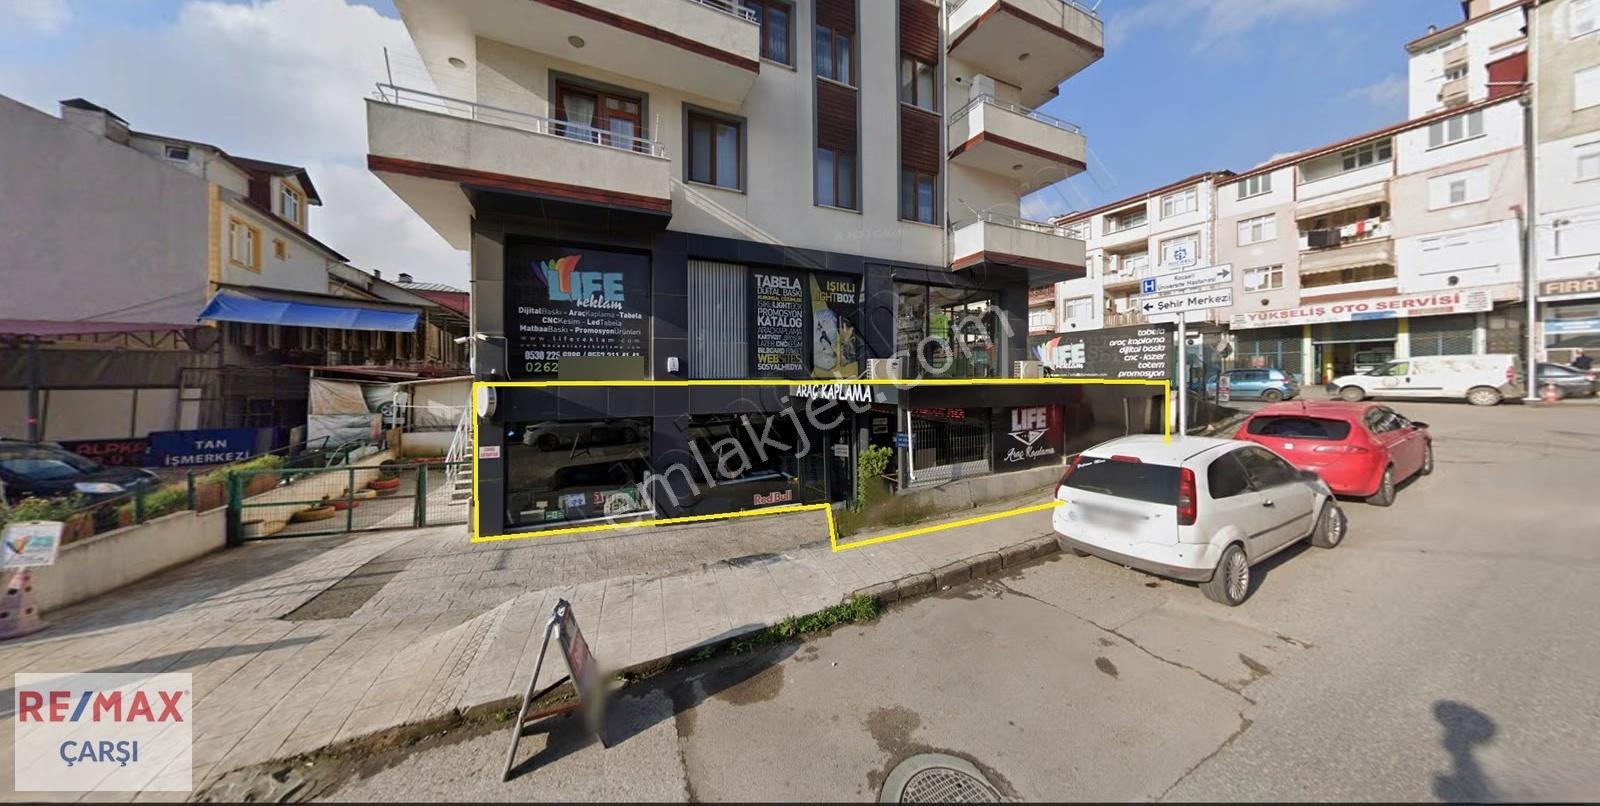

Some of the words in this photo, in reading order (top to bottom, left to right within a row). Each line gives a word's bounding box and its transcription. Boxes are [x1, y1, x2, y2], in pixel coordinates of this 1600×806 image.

[547, 271, 625, 301] LIFE
[754, 274, 802, 290] TABELA
[576, 294, 623, 310] reklam
[1157, 300, 1184, 310] Şehir
[1187, 294, 1231, 307] Merkezi
[1248, 305, 1326, 322] YÜKSELİŞ
[1332, 303, 1369, 314] OTO
[1376, 292, 1460, 310] SERVİSİ
[757, 307, 802, 319] PROMOSYON
[757, 316, 802, 328] KATALOG
[525, 362, 559, 373] 0262
[1137, 361, 1165, 370] totem
[1117, 370, 1165, 379] promosyon
[796, 384, 819, 399] ARAÇ
[821, 384, 872, 402] KAPLAMA
[1011, 406, 1048, 431] LIFE
[195, 439, 228, 450] TAN
[165, 451, 252, 466] İŞMERKEZİ
